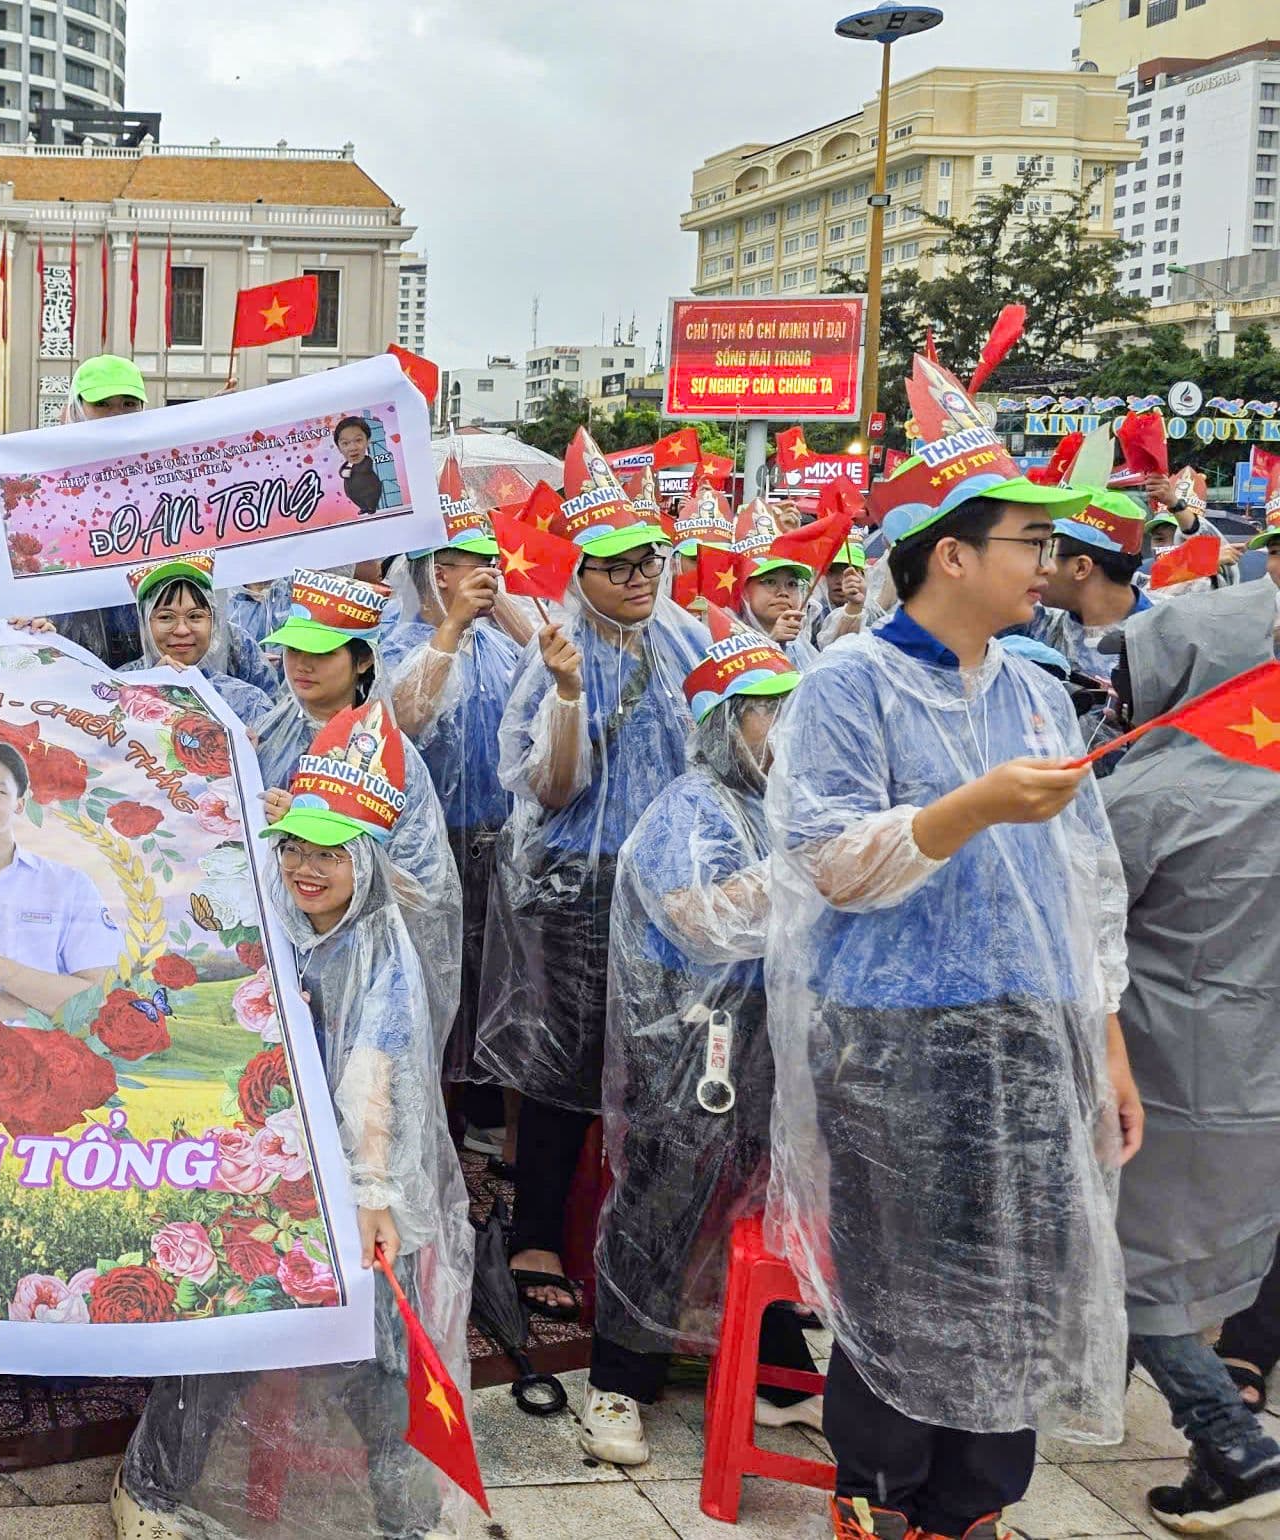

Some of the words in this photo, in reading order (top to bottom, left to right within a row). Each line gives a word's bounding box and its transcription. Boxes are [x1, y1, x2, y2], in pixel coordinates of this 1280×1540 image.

[686, 317, 708, 341] CHỦ
[712, 322, 736, 344] TỊCH
[738, 319, 754, 339] HỒ
[757, 318, 776, 338] CHÍ
[779, 321, 810, 338] MINH
[812, 318, 825, 338] VĨ
[826, 321, 847, 342] ĐẠI
[715, 345, 746, 367] SỐNG
[749, 348, 770, 366] MÃI
[774, 350, 812, 366] TRONG
[690, 376, 708, 398] SỰ
[709, 376, 749, 398] NGHIỆP
[753, 374, 775, 394] CỦA
[779, 374, 816, 394] CHÚNG
[819, 377, 833, 394] TA
[58, 475, 90, 490] THPT
[92, 464, 144, 483] CHUYÊN
[146, 458, 163, 473] LÊ
[164, 454, 191, 471] QUÝ
[192, 449, 221, 464] ĐÔN
[223, 444, 254, 458] NAM
[255, 438, 285, 452] NHA
[287, 427, 331, 446] TRANG
[919, 431, 988, 466] THANH
[154, 469, 201, 486] KHÁNH
[203, 461, 233, 477] HOÀ
[804, 461, 863, 479] MIXUE
[939, 459, 968, 481] TỰ
[969, 450, 998, 469] TIN
[664, 480, 689, 491] MIXUE
[562, 487, 617, 517] THANH
[571, 514, 589, 529] TỰ
[592, 505, 616, 520] TIN
[675, 519, 712, 531] THANH
[732, 534, 773, 552] THANH
[294, 568, 345, 596] THANH
[307, 592, 331, 607] TIN
[337, 603, 378, 623] CHIẾN
[723, 656, 746, 672] TỰ
[747, 650, 772, 663] TIN
[31, 699, 127, 747] CHIẾN
[300, 756, 361, 784] THANH
[365, 773, 407, 811] TÙNG
[299, 777, 316, 791] TỰ
[319, 779, 346, 795] TIN
[356, 792, 397, 825] CHIẾN
[18, 1109, 219, 1189] TỔNG
